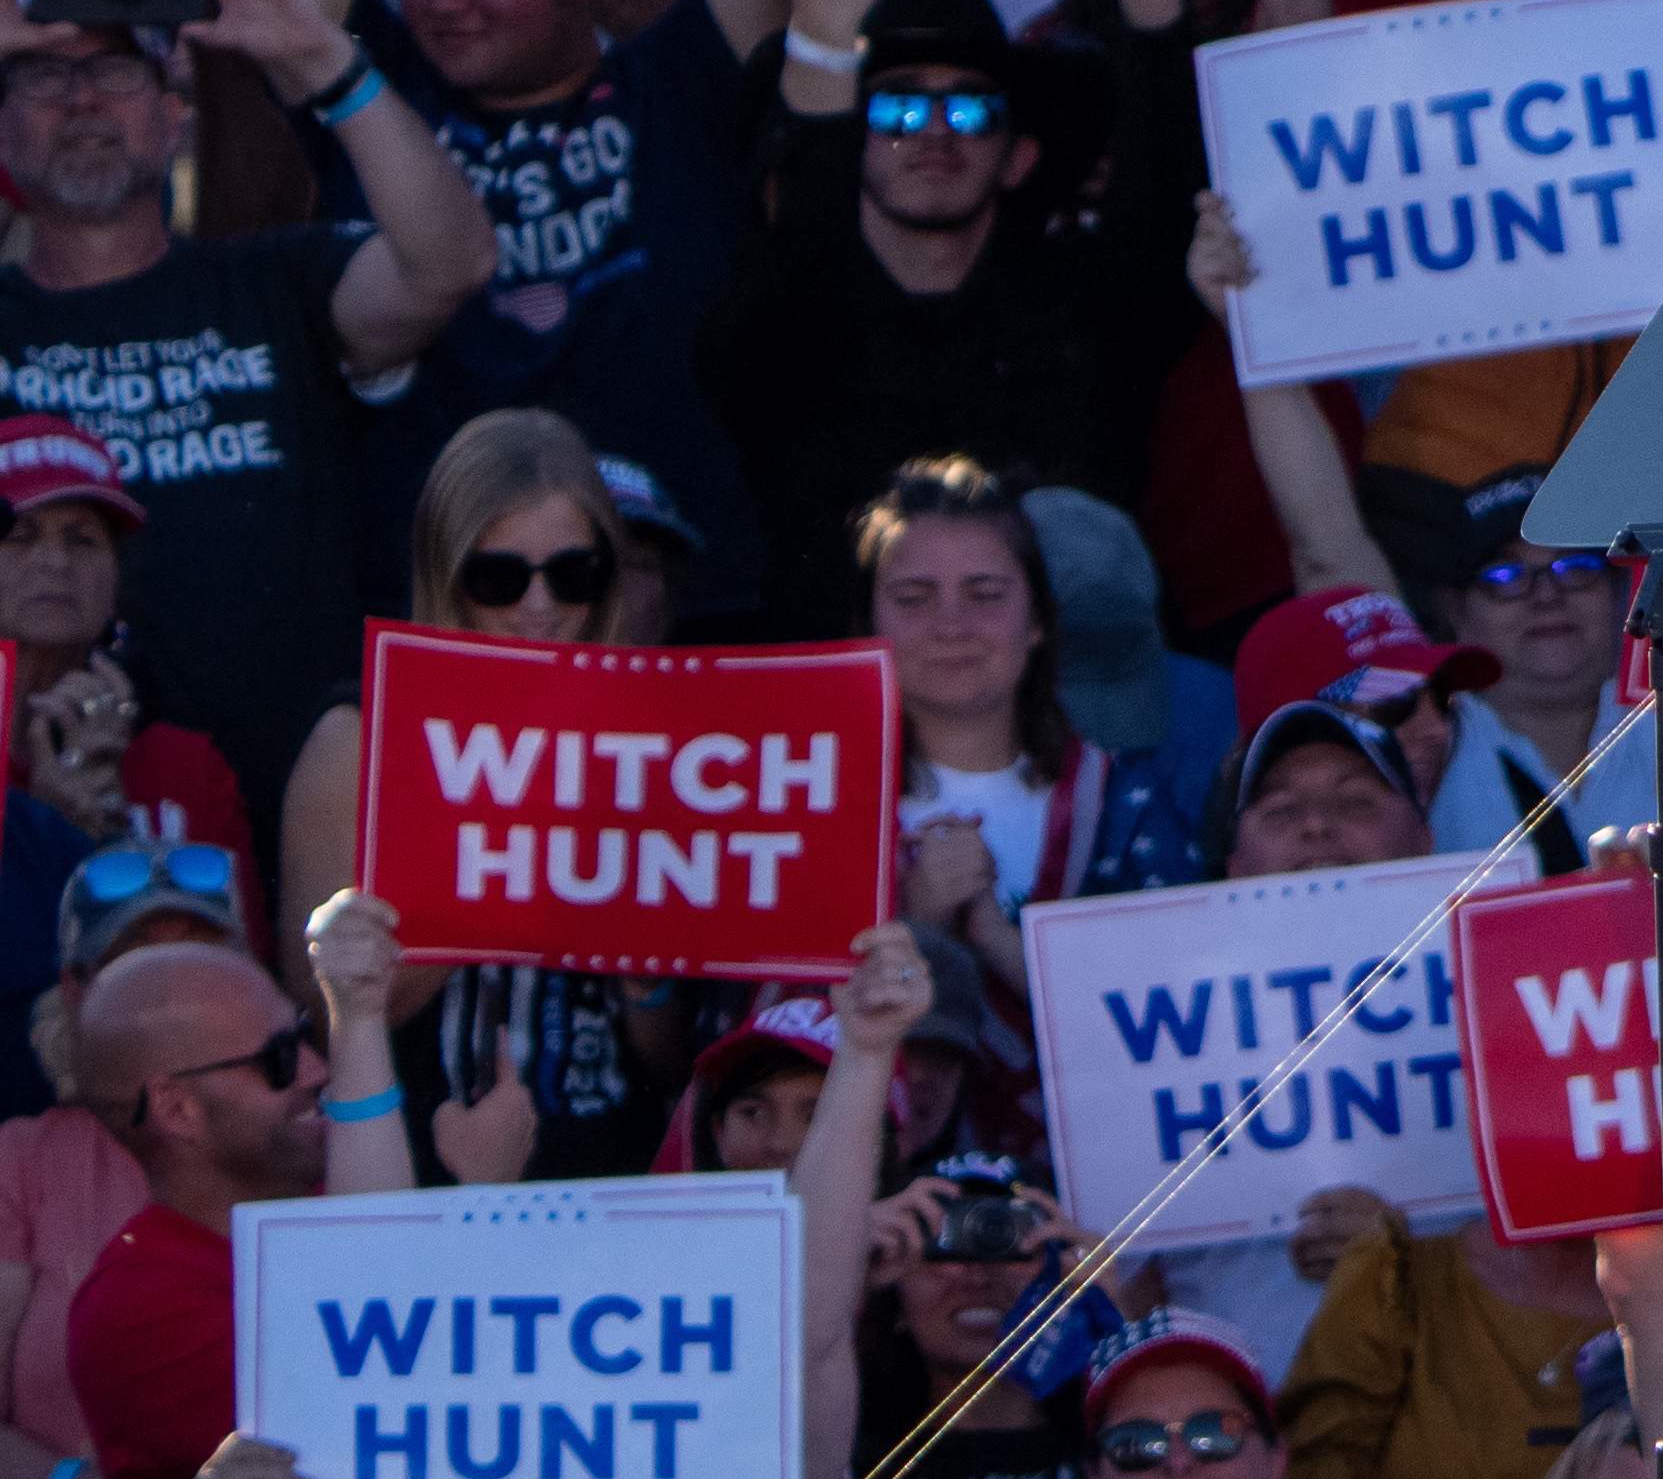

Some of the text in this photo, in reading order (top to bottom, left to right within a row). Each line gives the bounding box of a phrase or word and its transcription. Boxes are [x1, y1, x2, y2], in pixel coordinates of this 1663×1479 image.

[559, 115, 631, 184] GO
[1269, 68, 1658, 190] WITCH
[1321, 172, 1636, 288] HUNT
[101, 341, 150, 370] LET
[160, 345, 275, 405] RAGE
[424, 719, 839, 813] WITCH
[456, 821, 802, 910] HUNT
[1155, 1054, 1462, 1163] HUNT
[317, 1295, 734, 1376] WITCH
